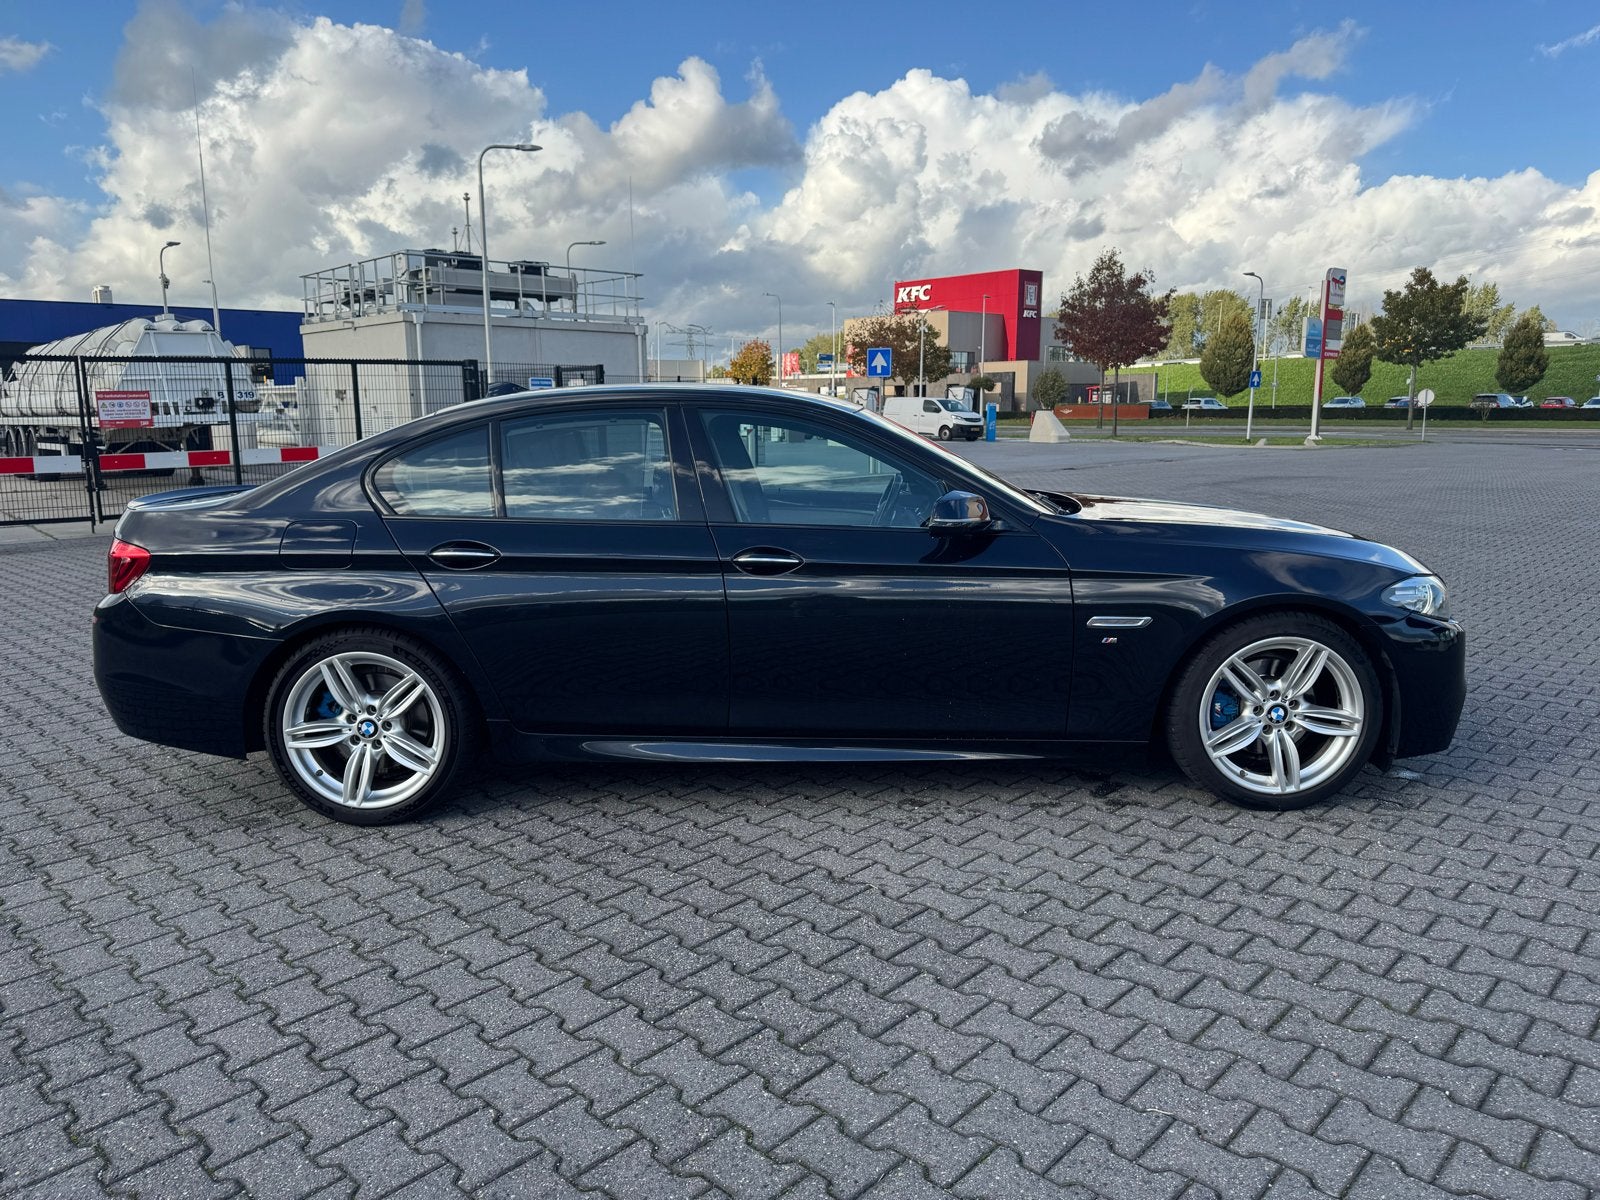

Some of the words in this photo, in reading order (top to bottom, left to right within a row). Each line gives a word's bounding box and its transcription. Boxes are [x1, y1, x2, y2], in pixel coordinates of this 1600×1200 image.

[896, 285, 931, 303] KFC
[1023, 310, 1037, 318] KFC
[237, 391, 254, 399] 319
